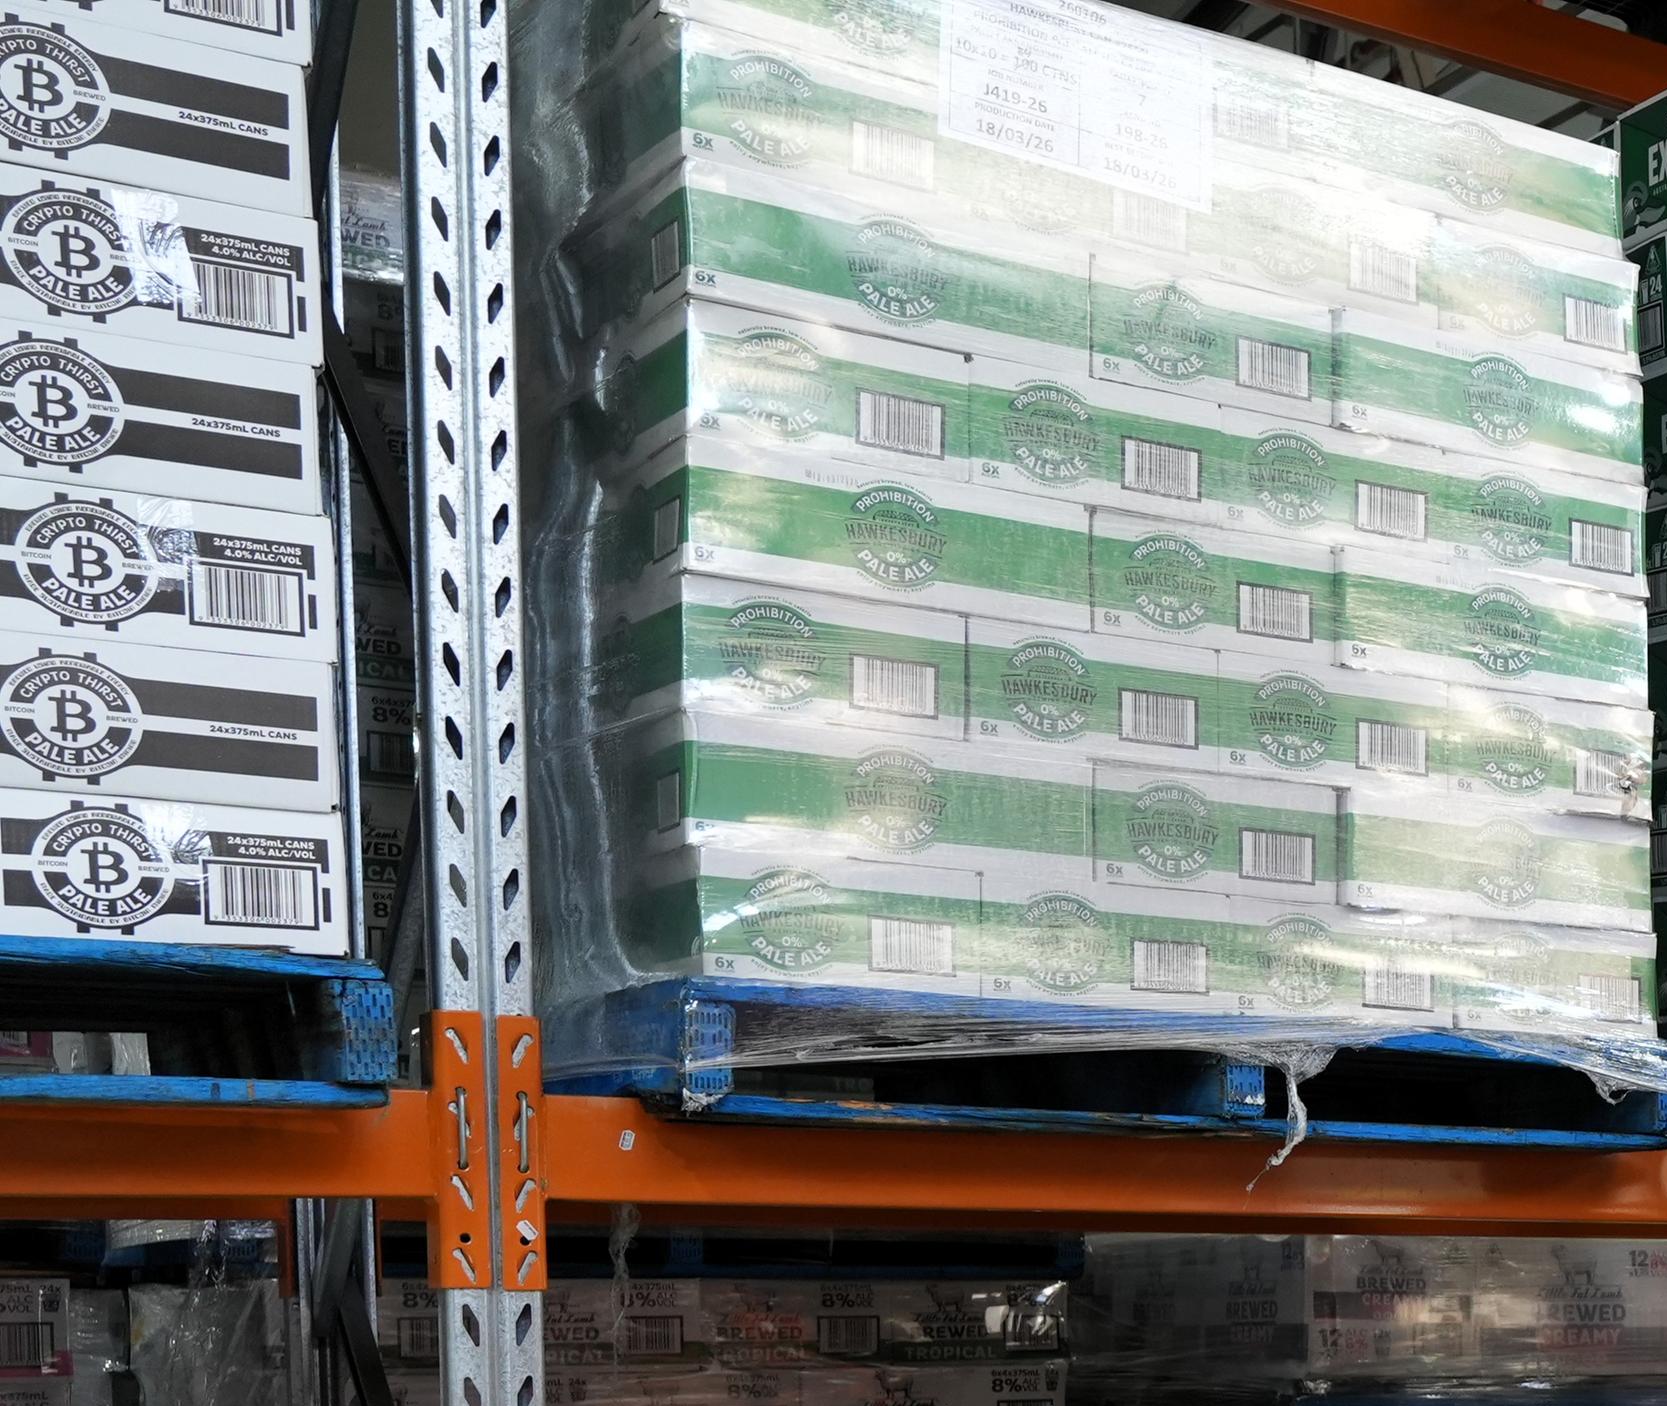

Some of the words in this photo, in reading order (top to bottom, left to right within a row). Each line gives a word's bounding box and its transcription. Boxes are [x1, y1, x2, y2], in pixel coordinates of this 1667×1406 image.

[974, 101, 1032, 125] PRODUCTION
[1034, 118, 1055, 131] DATE
[975, 118, 1054, 153] 18/03/26
[23, 205, 74, 231] CRYPTO
[8, 237, 38, 247] BITCOIN
[201, 233, 258, 252] 24x375mL
[260, 244, 291, 257] CANS
[211, 245, 240, 260] 4.0%
[241, 250, 292, 267] ALC/VOL
[30, 267, 81, 301] PALE
[88, 276, 124, 302] ALE
[213, 537, 270, 554] 24x375mL
[271, 544, 302, 556] CANS
[41, 576, 95, 611] PALE
[100, 586, 138, 610] ALE
[1010, 644, 1086, 677] PROHIBITION
[20, 670, 70, 698] CRYPTO
[78, 672, 124, 708] THIRST
[1001, 678, 1098, 707] HAWKESBURY
[1259, 679, 1327, 709] PROHIBITION
[4, 705, 35, 714] BITCOIN
[106, 715, 138, 724] BREWED
[1012, 702, 1056, 736] PALE
[1056, 710, 1087, 736] ALE
[1250, 711, 1338, 736] HAWKESBURY
[209, 724, 266, 738] 24x375mL
[268, 731, 298, 740] CANS
[25, 731, 76, 764] PALE
[82, 737, 120, 764] ALE
[1260, 732, 1297, 762] PALE
[1299, 741, 1327, 764] ALE
[52, 823, 102, 852] CRYPTO
[109, 824, 153, 858] THIRST
[227, 836, 285, 848] 24x375mL
[286, 840, 315, 850] CANS
[1126, 821, 1219, 848] HAWKESBURY
[238, 846, 266, 856] 4.0%
[267, 848, 316, 860] ALC/VOL
[58, 884, 110, 915] PALE
[116, 890, 153, 915] ALE
